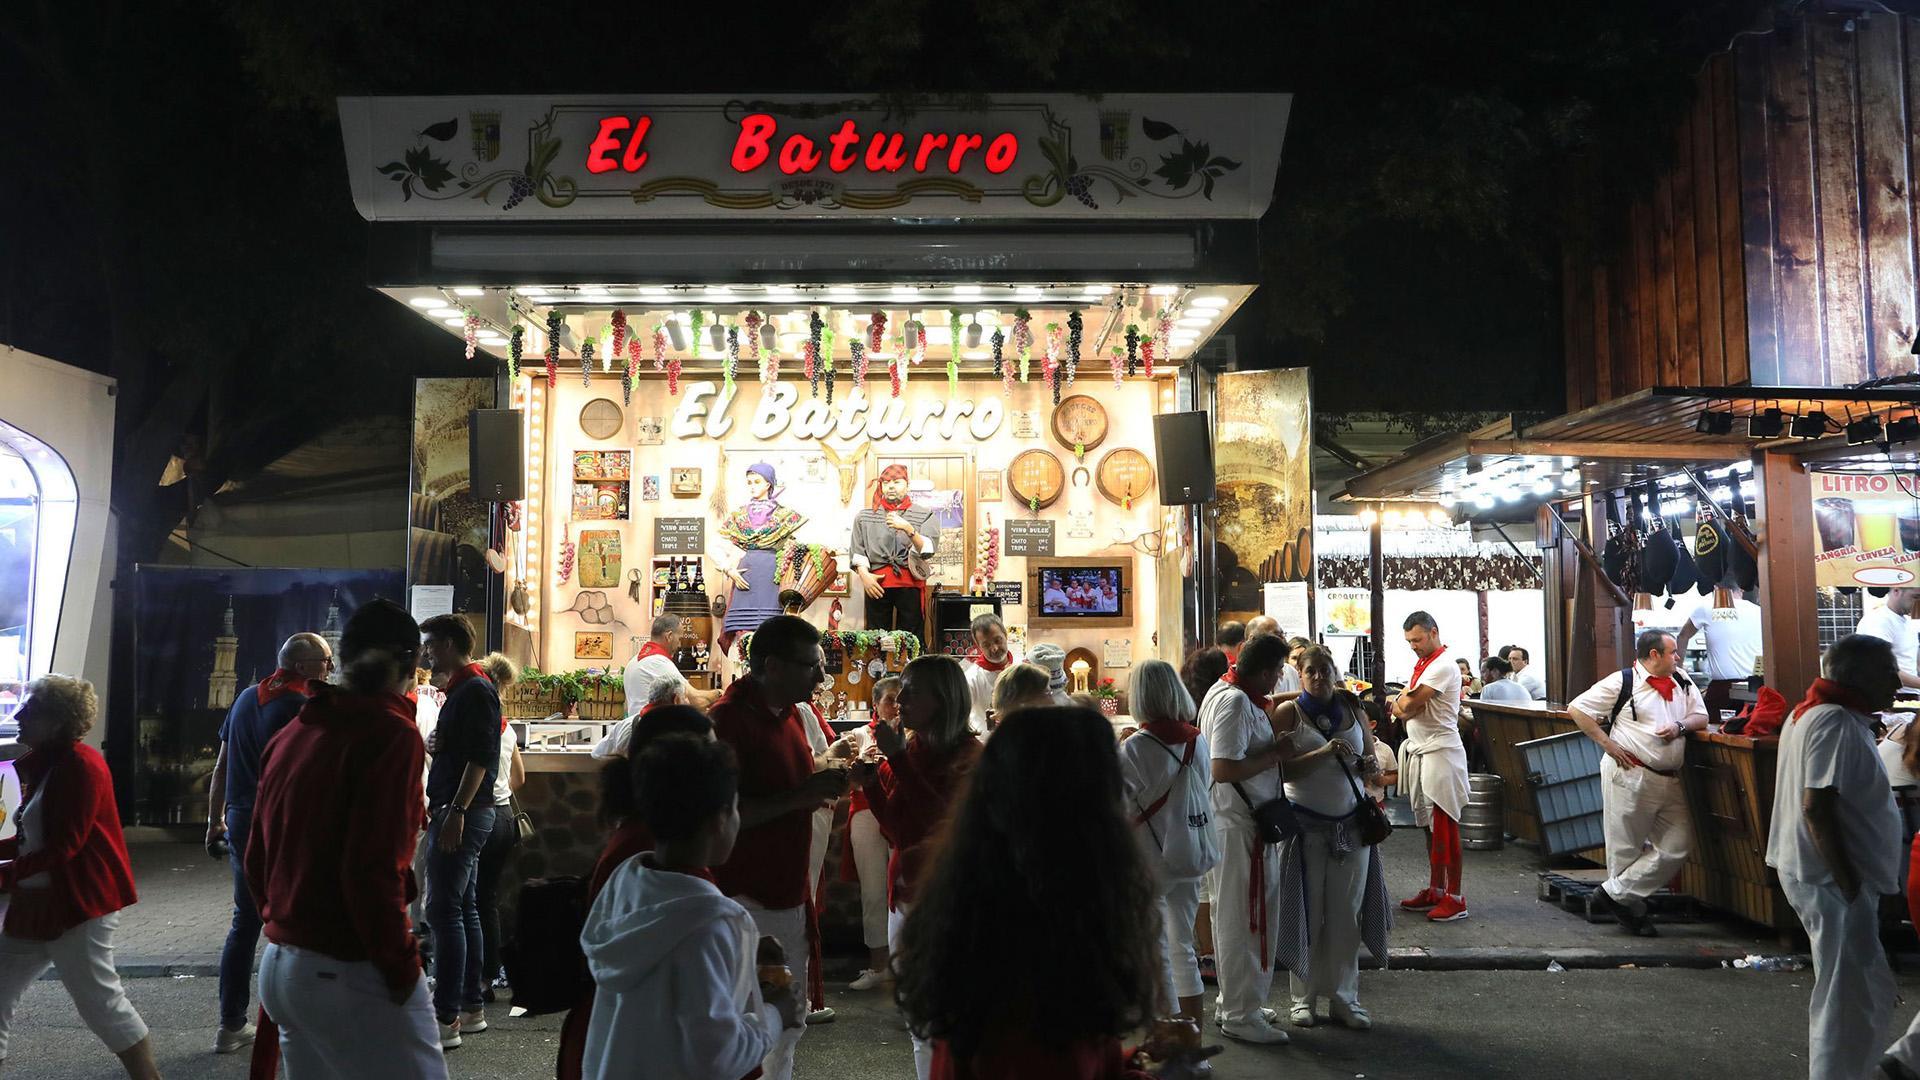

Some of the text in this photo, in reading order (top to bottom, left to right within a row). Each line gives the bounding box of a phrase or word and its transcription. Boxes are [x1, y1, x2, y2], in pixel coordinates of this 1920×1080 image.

[586, 114, 1018, 174] El Baturro
[670, 380, 1005, 442] El Baturro
[1822, 475, 1889, 492] LITRO
[1855, 547, 1896, 562] CERVEZA
